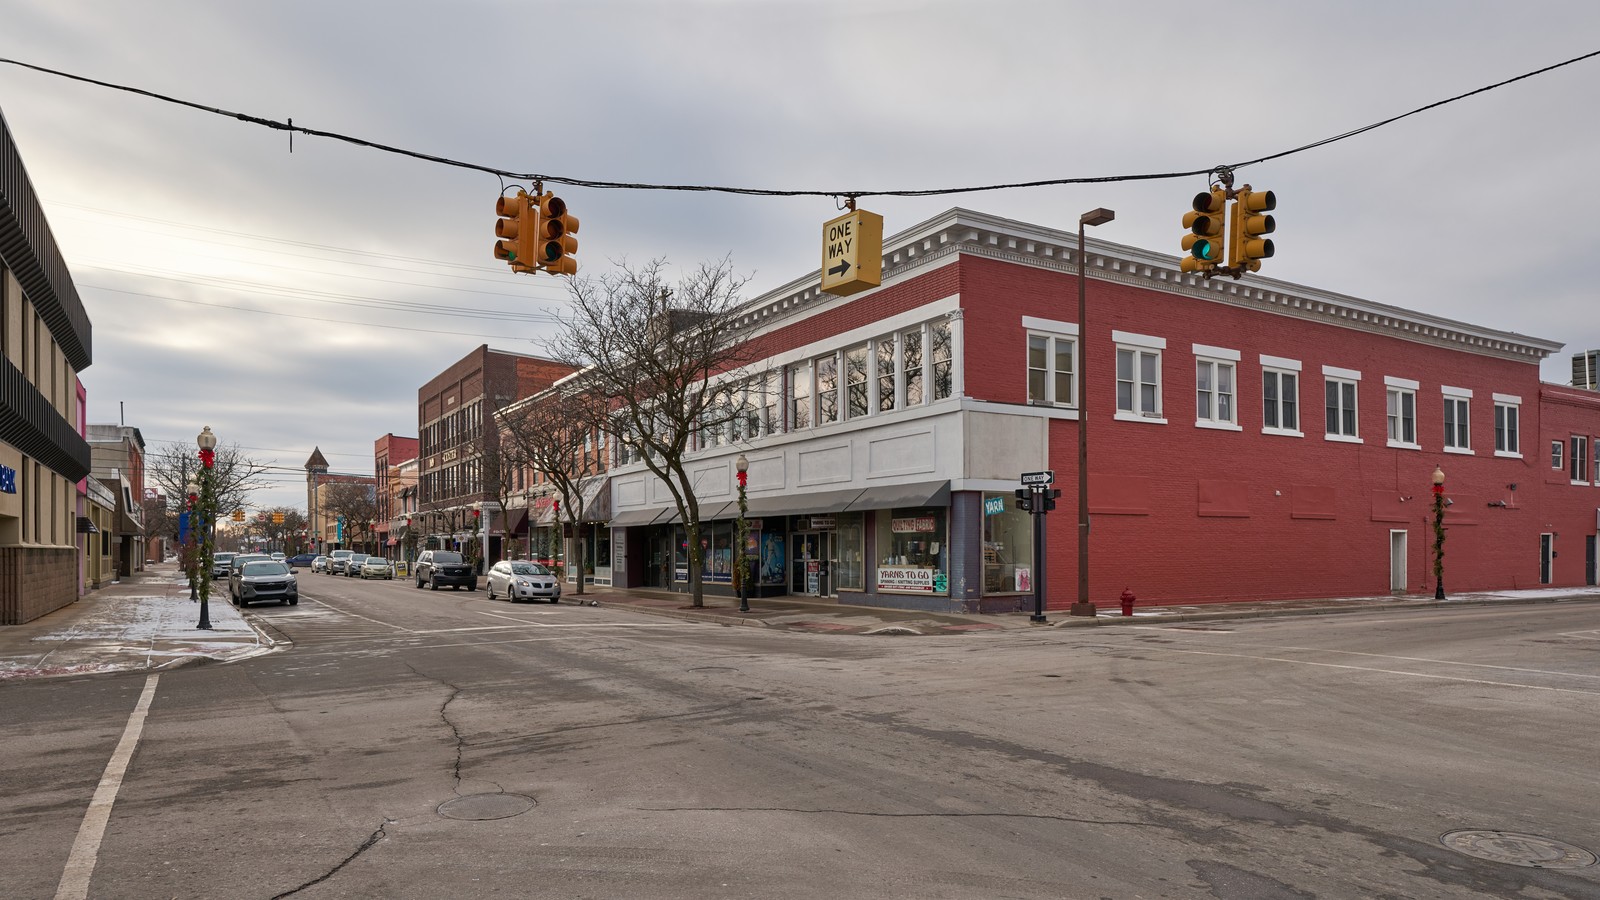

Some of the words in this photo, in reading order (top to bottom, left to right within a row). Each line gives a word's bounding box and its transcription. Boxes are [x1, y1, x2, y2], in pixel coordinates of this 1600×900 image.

[829, 221, 852, 242] ONE
[828, 238, 852, 260] WAY
[985, 498, 1004, 514] YARN
[893, 520, 914, 531] QUILTING
[881, 571, 904, 579] YARNS
[906, 571, 916, 579] TO
[918, 571, 929, 579] GO
